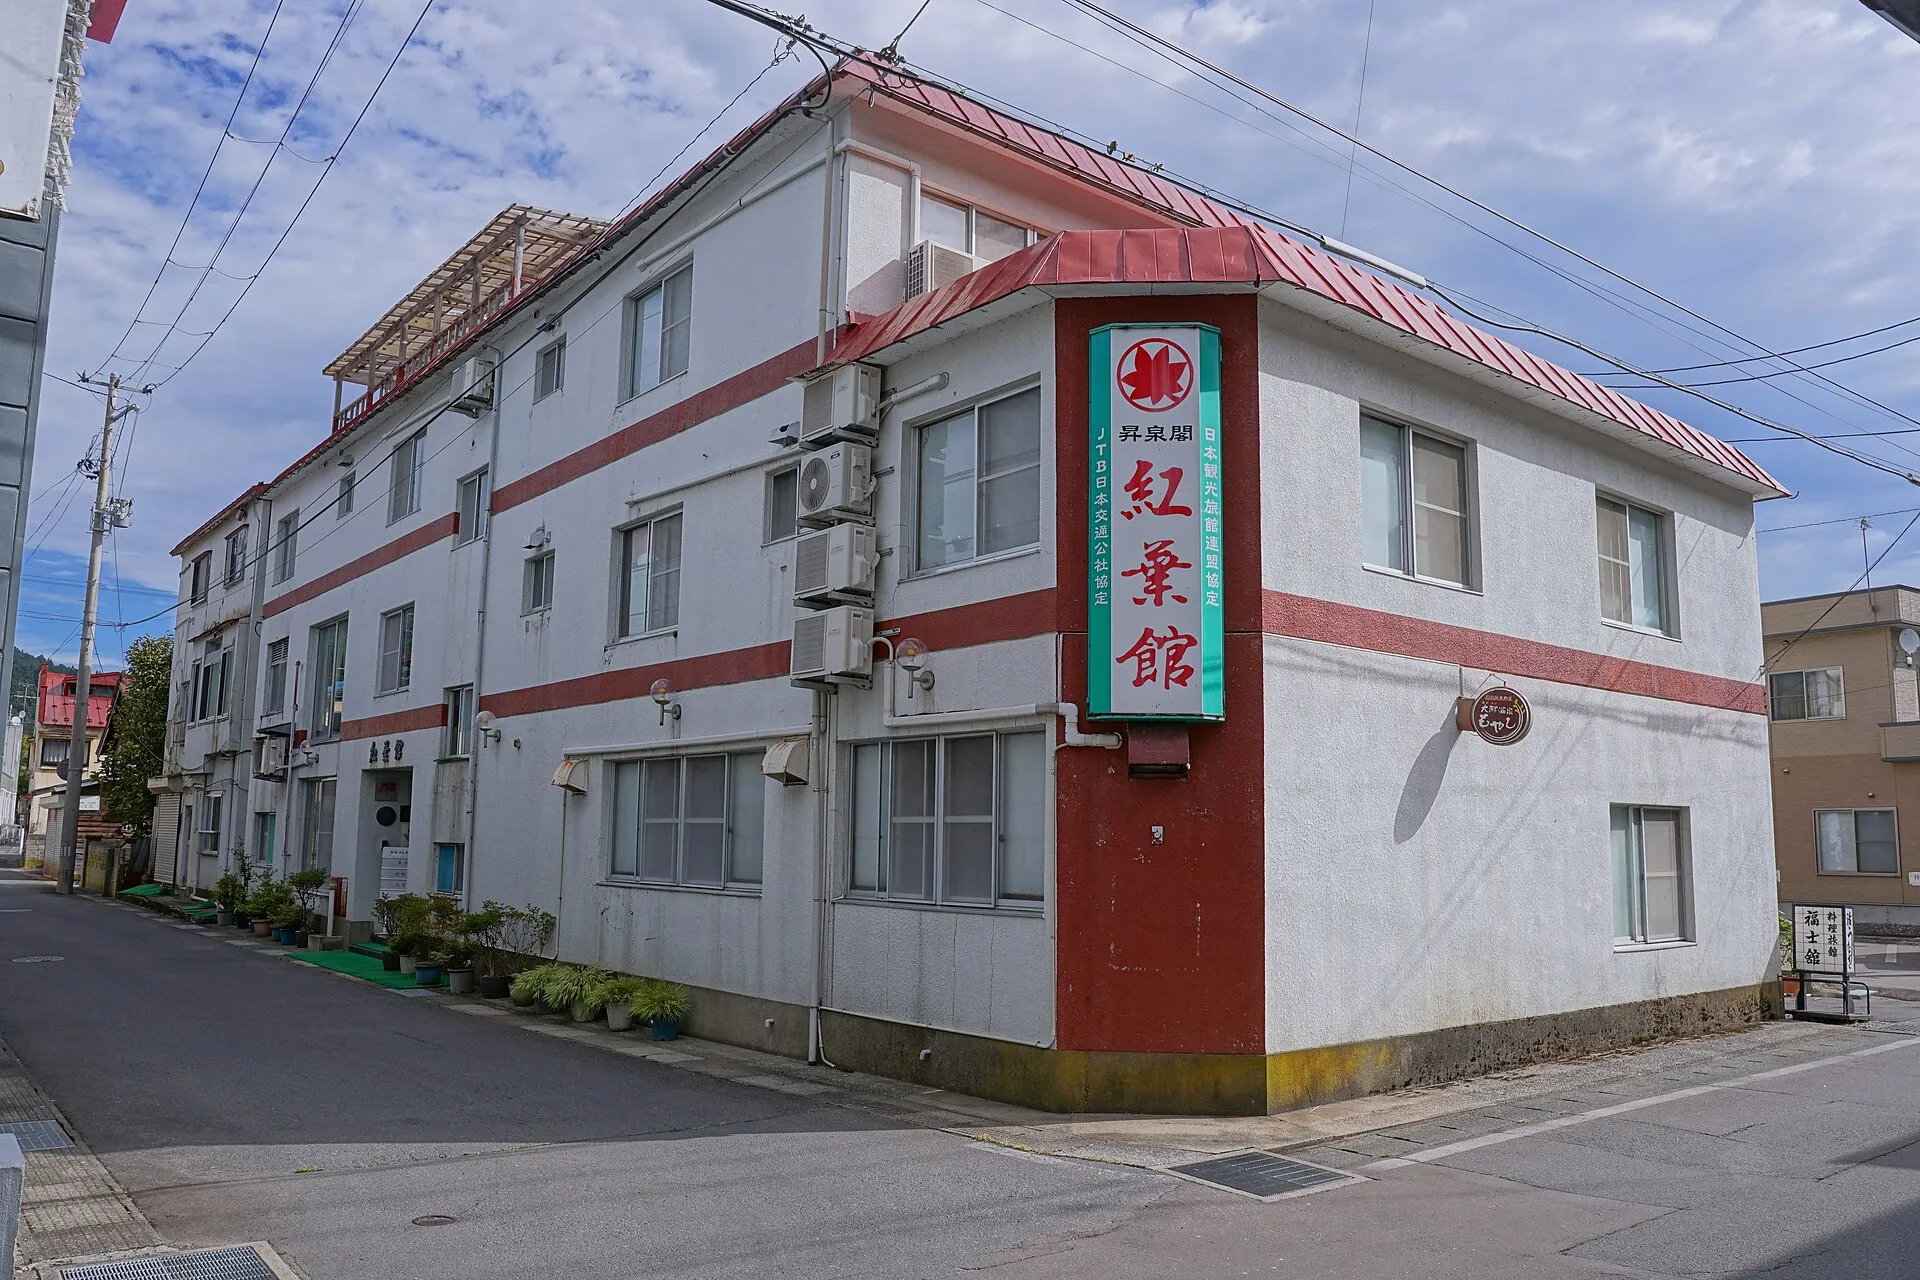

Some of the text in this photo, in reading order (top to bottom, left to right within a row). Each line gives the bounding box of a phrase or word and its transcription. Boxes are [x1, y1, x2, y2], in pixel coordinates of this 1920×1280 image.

[1094, 427, 1109, 606] JTB日本交通公社協定
[1119, 424, 1193, 443] 昇泉閣
[1203, 427, 1220, 607] 日本観光旅館連盟協定
[1116, 460, 1198, 690] 紅葉館
[1479, 714, 1516, 732] もやし
